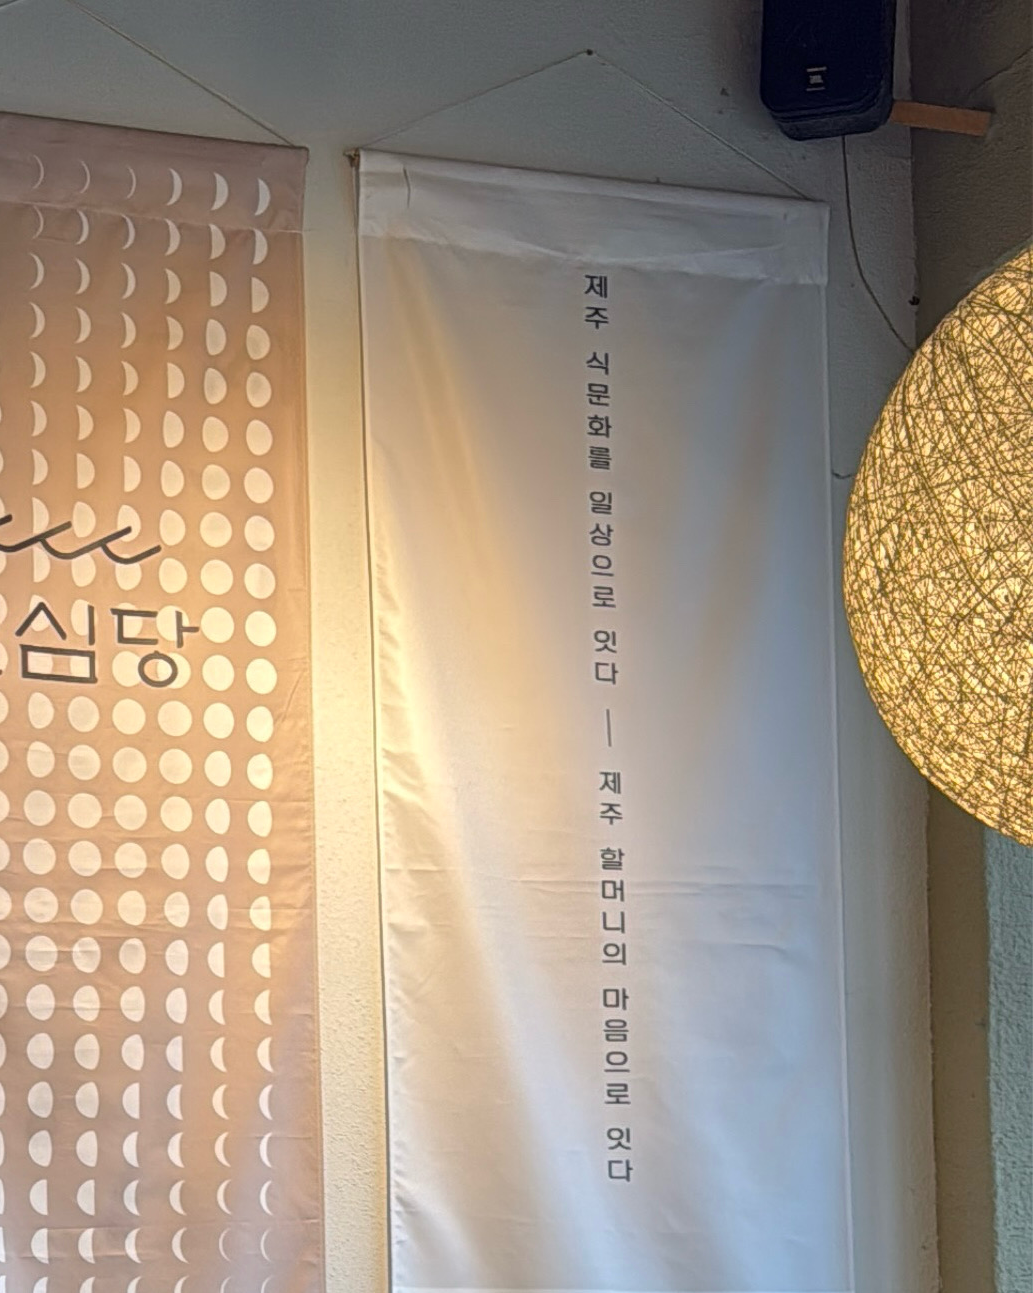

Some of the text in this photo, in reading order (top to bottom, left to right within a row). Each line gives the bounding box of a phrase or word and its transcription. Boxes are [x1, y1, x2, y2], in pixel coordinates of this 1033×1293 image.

[584, 274, 609, 330] 제주
[586, 352, 612, 470] 식문화를
[589, 491, 616, 608] 일상으로
[593, 630, 619, 685] 잇다
[599, 771, 623, 825] 제주
[600, 847, 627, 965] 할머니의
[603, 988, 631, 1105] 마음으로
[607, 1127, 634, 1182] 잇다
